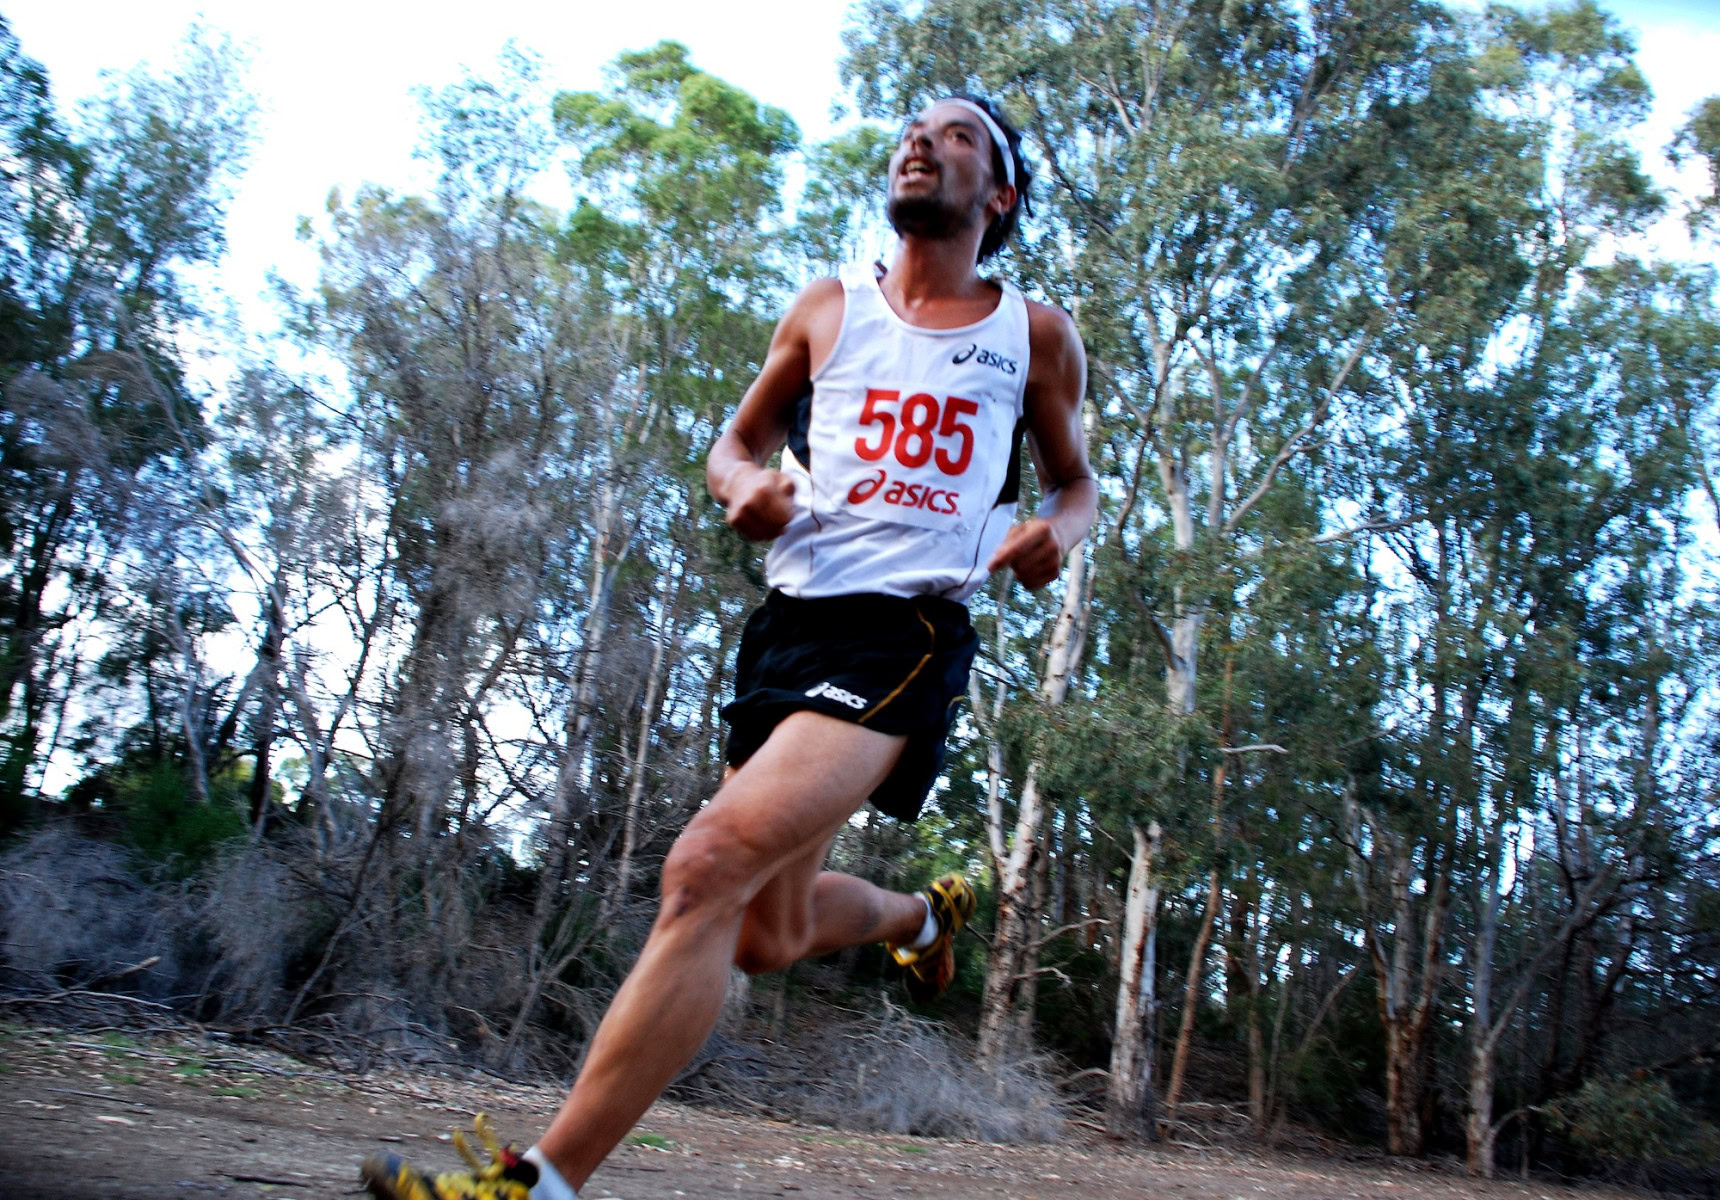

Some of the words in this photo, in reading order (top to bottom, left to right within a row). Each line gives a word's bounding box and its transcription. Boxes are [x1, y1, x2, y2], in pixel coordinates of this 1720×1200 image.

[976, 350, 1018, 375] asics
[854, 388, 979, 477] 585
[884, 480, 960, 515] asics
